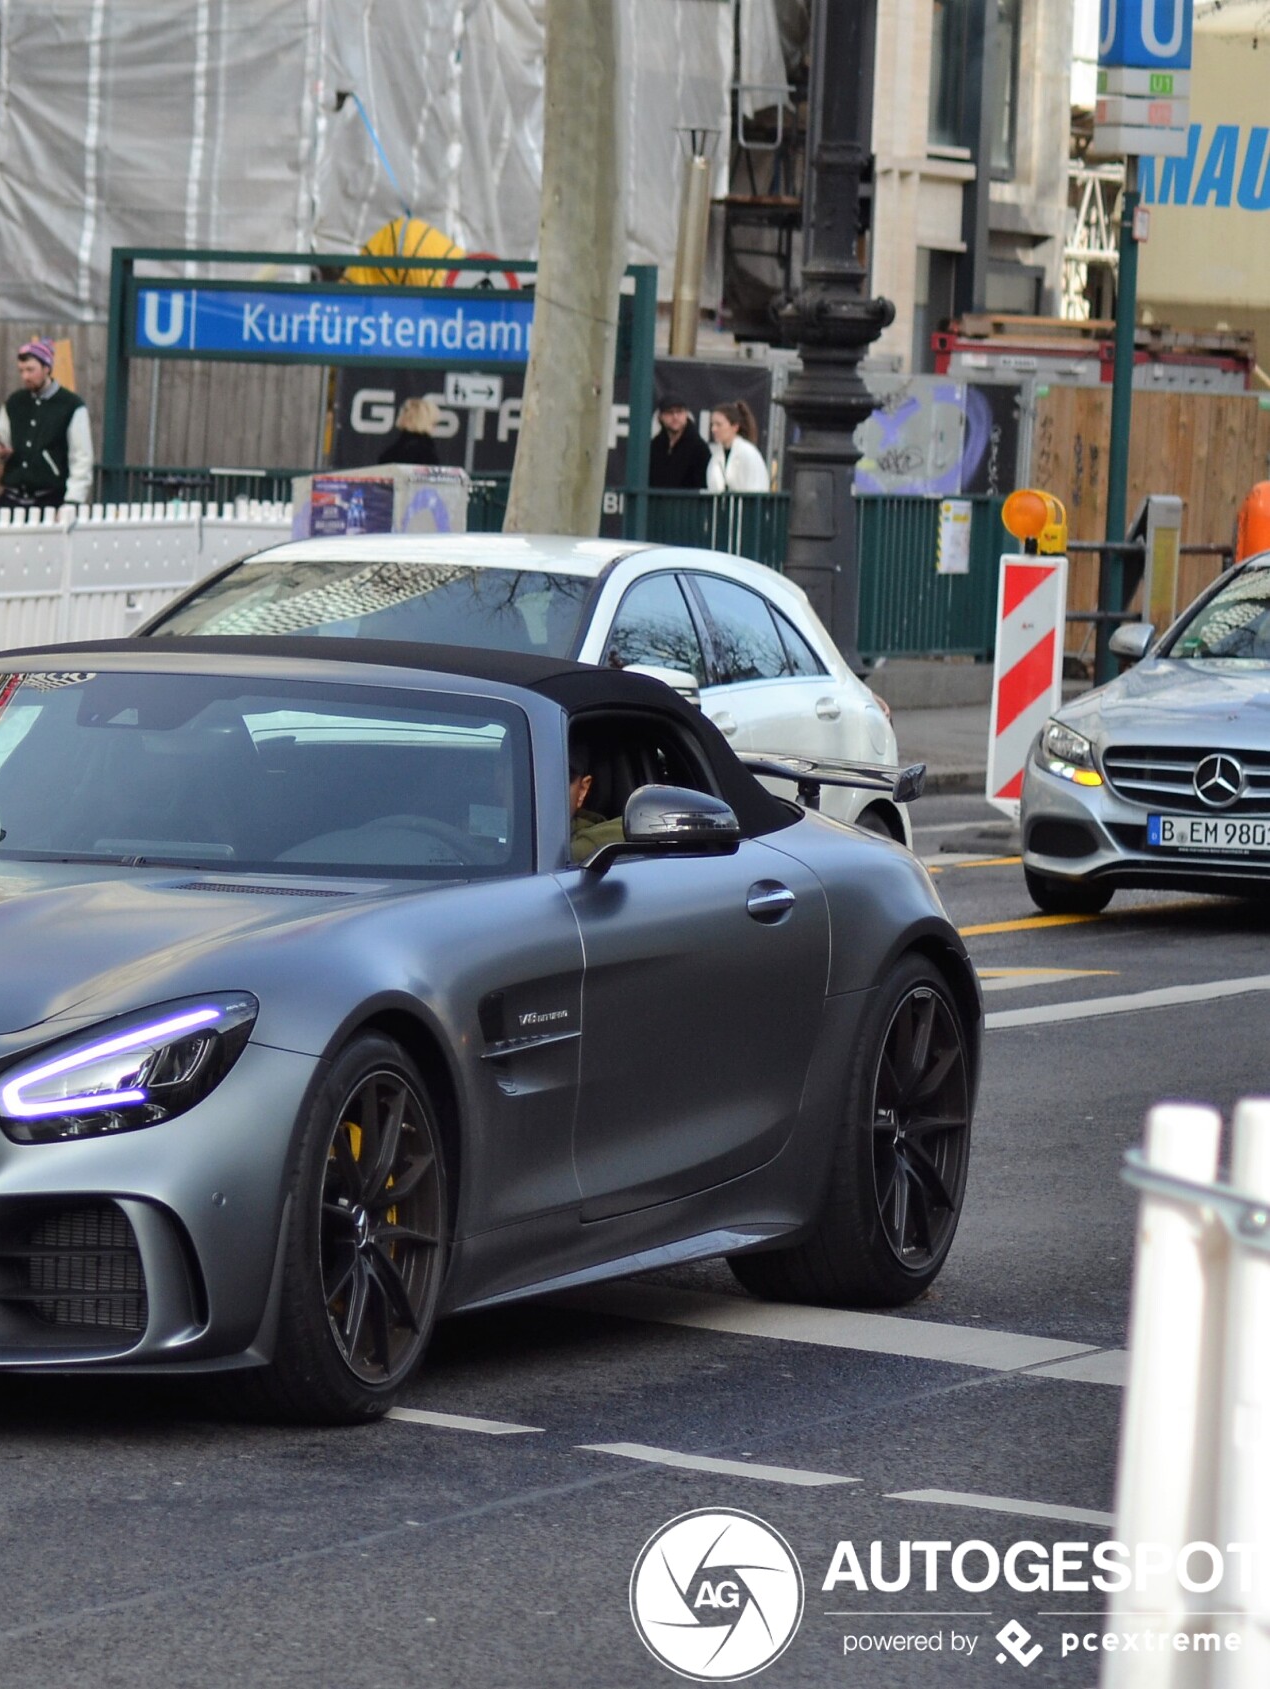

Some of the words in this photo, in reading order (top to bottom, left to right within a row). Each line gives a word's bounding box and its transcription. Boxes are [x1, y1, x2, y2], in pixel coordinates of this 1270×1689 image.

[143, 291, 185, 346] U
[1162, 820, 1175, 841] B
[1190, 821, 1219, 844] EM
